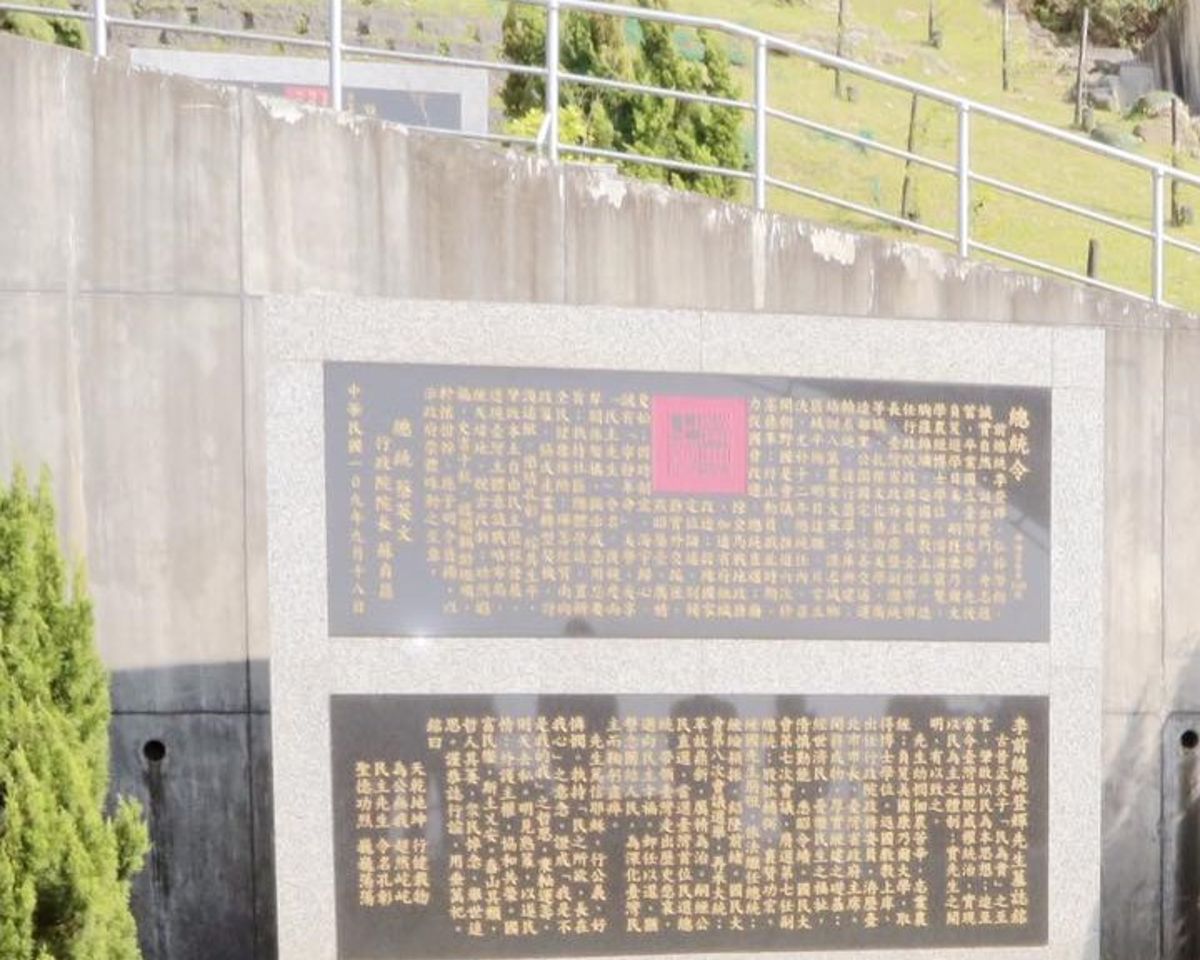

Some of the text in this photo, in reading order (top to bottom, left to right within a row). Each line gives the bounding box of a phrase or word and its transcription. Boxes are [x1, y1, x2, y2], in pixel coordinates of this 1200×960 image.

[1008, 406, 1031, 483] 總統令
[1010, 716, 1029, 926] 李前總統登輝先生墓誌銘
